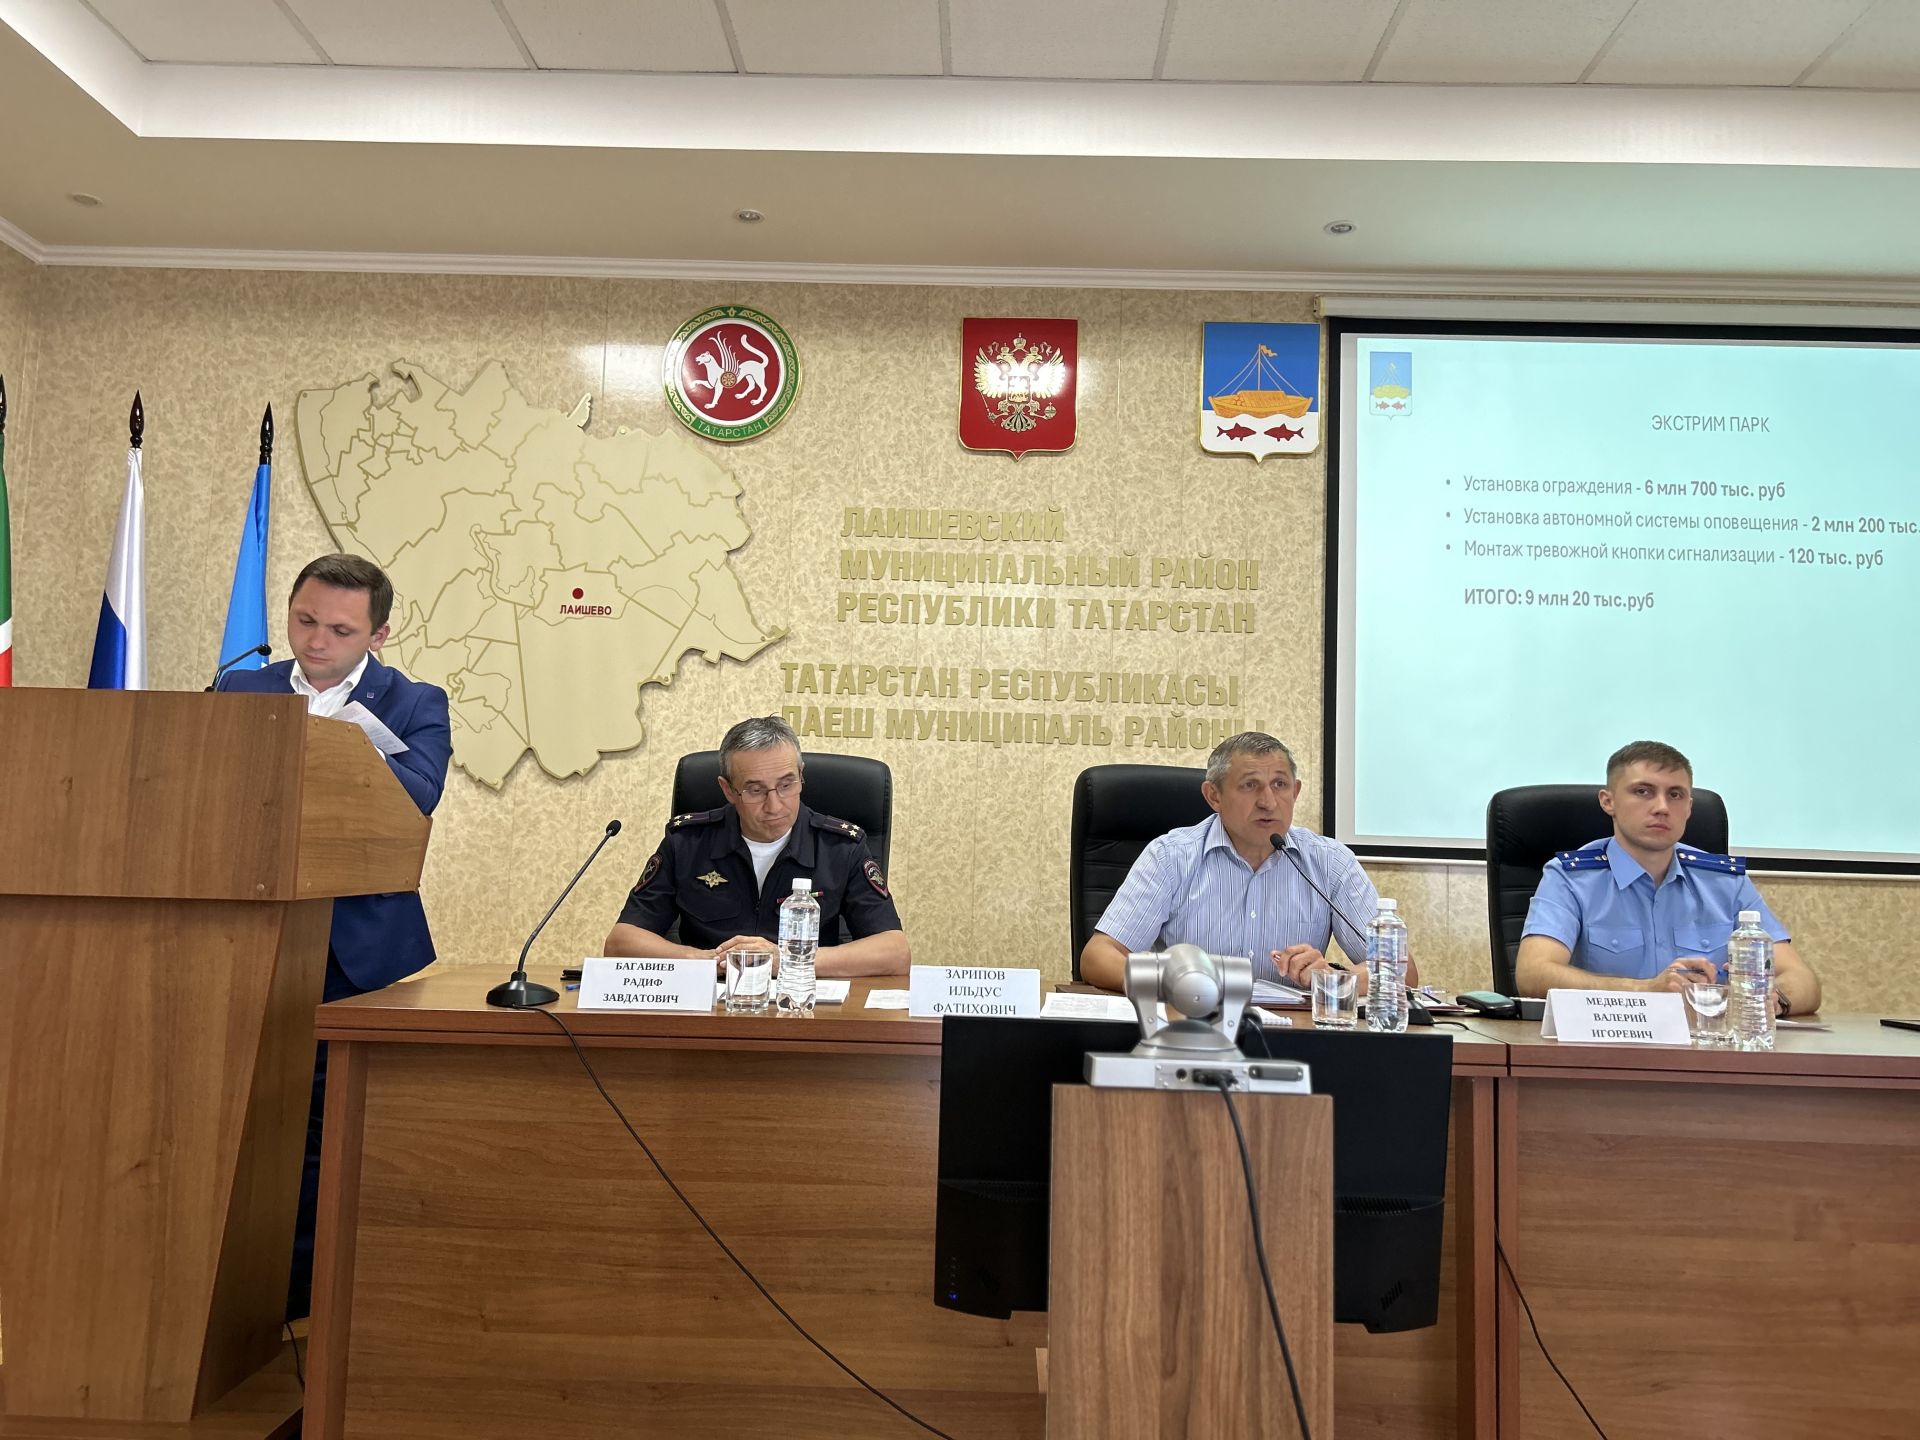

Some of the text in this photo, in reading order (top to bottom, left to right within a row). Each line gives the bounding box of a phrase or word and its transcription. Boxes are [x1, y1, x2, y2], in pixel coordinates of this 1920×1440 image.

[698, 421, 763, 438] ТАТАРСТАН
[1651, 414, 1771, 433] ЭКСТРИМ ПАРК
[1463, 474, 1539, 493] Установка
[1542, 480, 1633, 497] ограждения
[1644, 479, 1654, 496] 6
[1656, 482, 1687, 496] млн
[1690, 480, 1718, 497] 700
[1720, 484, 1755, 498] тыс.
[1758, 481, 1786, 502] руб
[840, 504, 1064, 542] ЛАИШЕВСКИЙ
[1463, 507, 1540, 526] Установка
[1542, 511, 1633, 528] автономной
[1635, 514, 1700, 529] системы
[1703, 516, 1799, 534] оповещения
[1811, 516, 1821, 532] 2
[1823, 519, 1855, 533] млн
[1857, 517, 1886, 534] 200
[1464, 539, 1524, 557] Монтаж
[1526, 542, 1609, 561] тревожной
[1611, 546, 1665, 561] кнопки
[1667, 547, 1775, 566] сигнализации
[1788, 547, 1815, 565] 120
[1817, 551, 1853, 566] тыс.
[1855, 548, 1884, 570] руб
[840, 548, 1259, 590] МУНИЦИПАЛЬНЫЙ РАЙОН
[1464, 587, 1655, 613] ИТОГО: 9 млн 20 тыс.руб
[560, 604, 612, 616] ЛАИШЕВО
[837, 591, 1255, 634] РЕСПУБЛИКИ ТАТАРСТАН
[780, 662, 1239, 707] ТАТАРСТАН РЕСПУБЛИКАСЫ
[885, 708, 1113, 748] МУНИЦИПАЛЬ
[615, 962, 675, 972] БАГАВИЕВ
[945, 969, 1005, 980] ЗАРИПОВ
[623, 977, 663, 988] РАДИФ
[602, 993, 679, 1004] ЗАВДАТОВИЧ
[949, 986, 1002, 998] ИЛЬДУС
[933, 1002, 1016, 1015] ФАТИХОВИЧ
[1586, 997, 1647, 1008] МЕДВЕДЕВ
[1593, 1012, 1647, 1023] ВАЛЕРИЙ
[1591, 1029, 1653, 1039] ИГОРЕВИЧ
